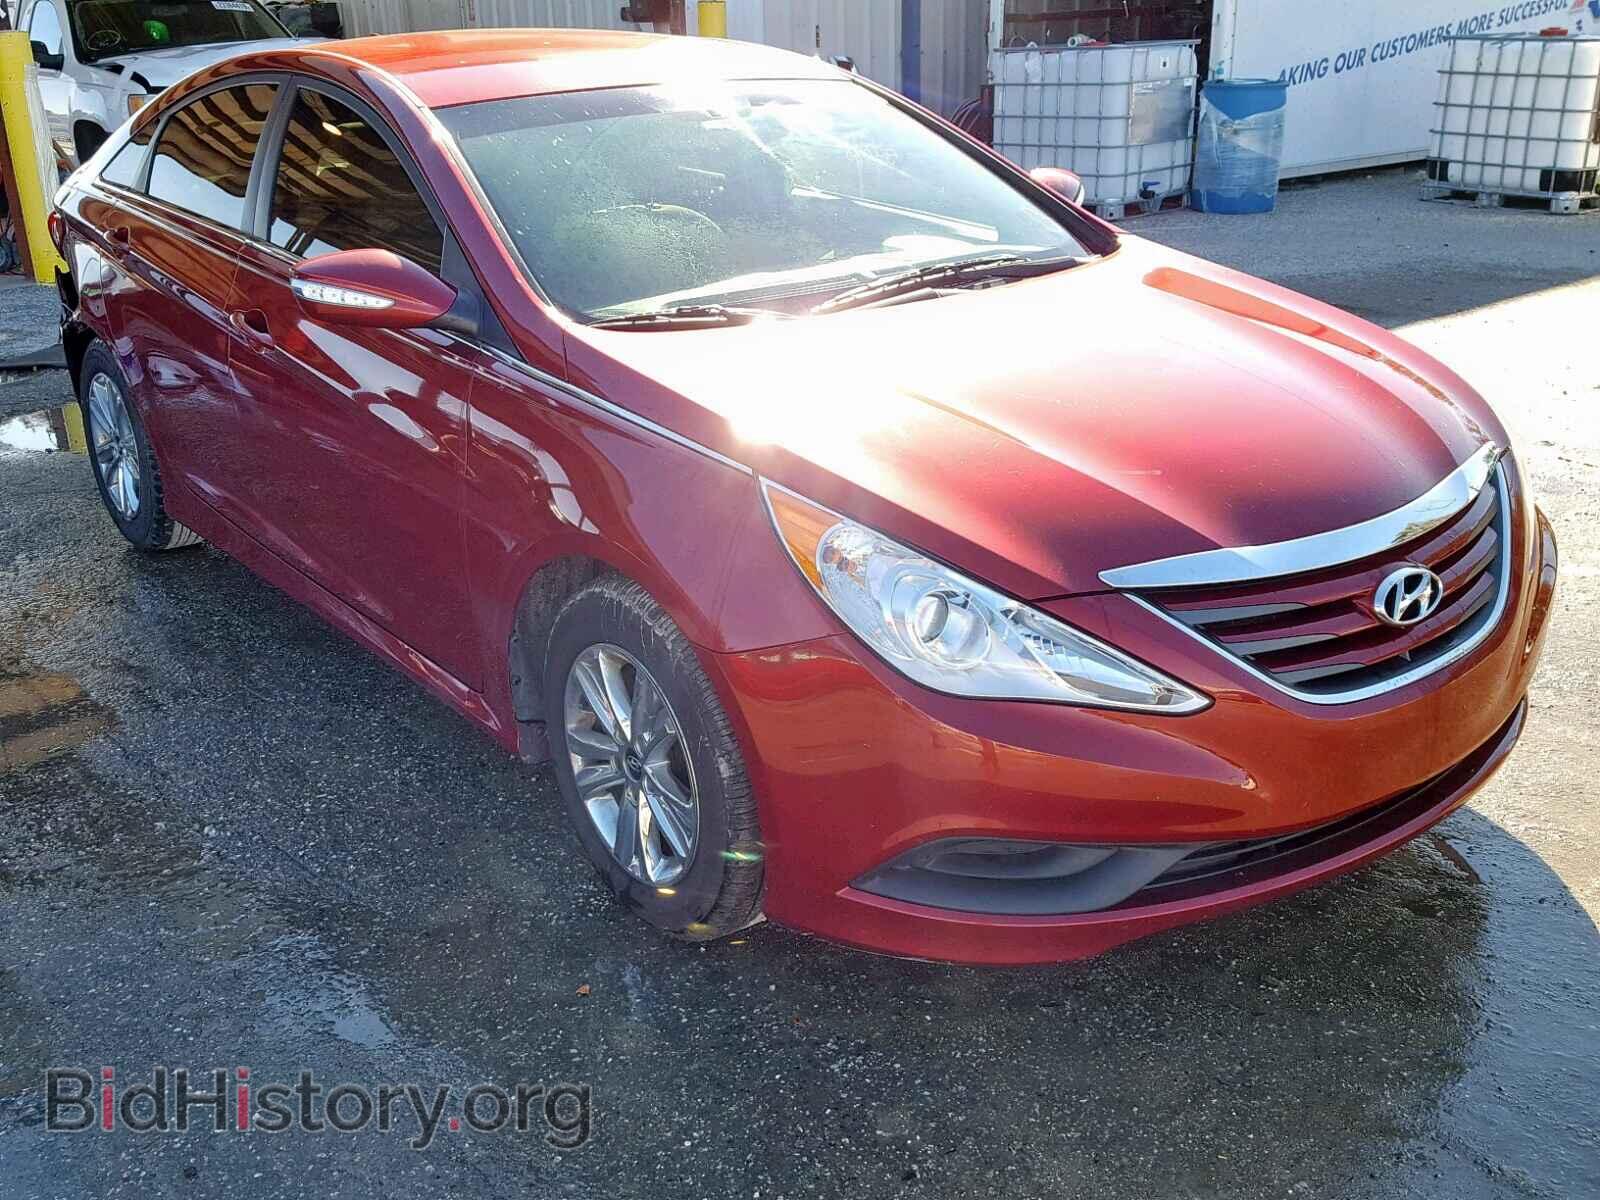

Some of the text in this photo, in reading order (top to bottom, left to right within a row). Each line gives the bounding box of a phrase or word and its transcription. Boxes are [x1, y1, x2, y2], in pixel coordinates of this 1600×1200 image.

[1279, 57, 1329, 86] AKING
[1334, 51, 1366, 74] OUR
[1371, 23, 1452, 63] CUSTOMERS
[1456, 12, 1494, 36] MORE
